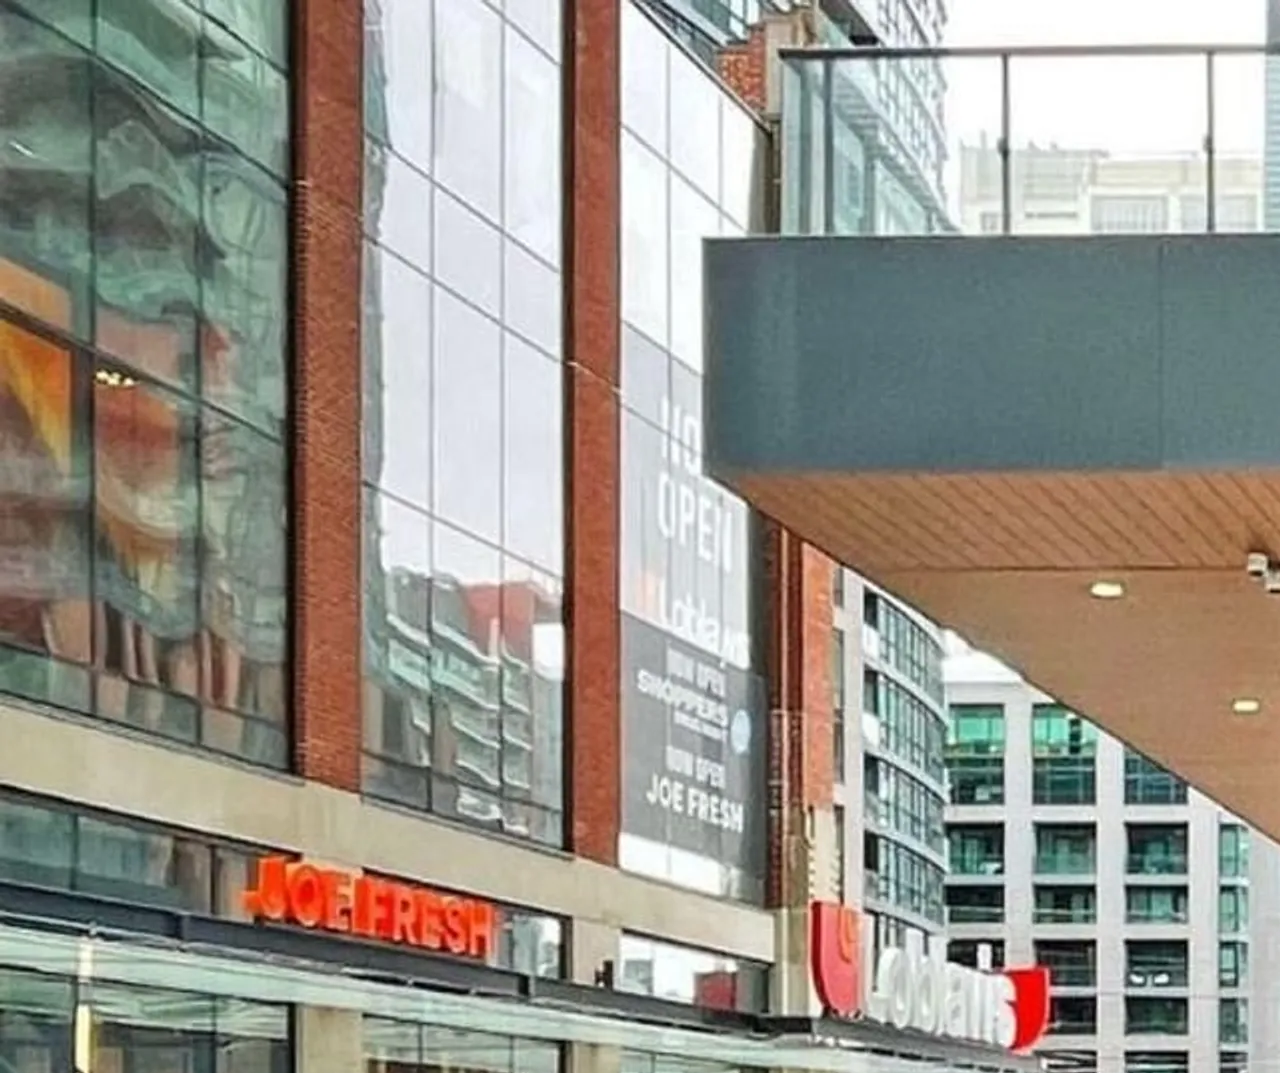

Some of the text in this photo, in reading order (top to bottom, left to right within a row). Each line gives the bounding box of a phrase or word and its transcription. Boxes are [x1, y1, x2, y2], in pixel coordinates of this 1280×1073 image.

[656, 470, 732, 573] OPEN
[637, 668, 728, 727] SHOPPERS
[646, 773, 744, 833] JOE FRESH
[243, 856, 494, 963] JOE FRESH
